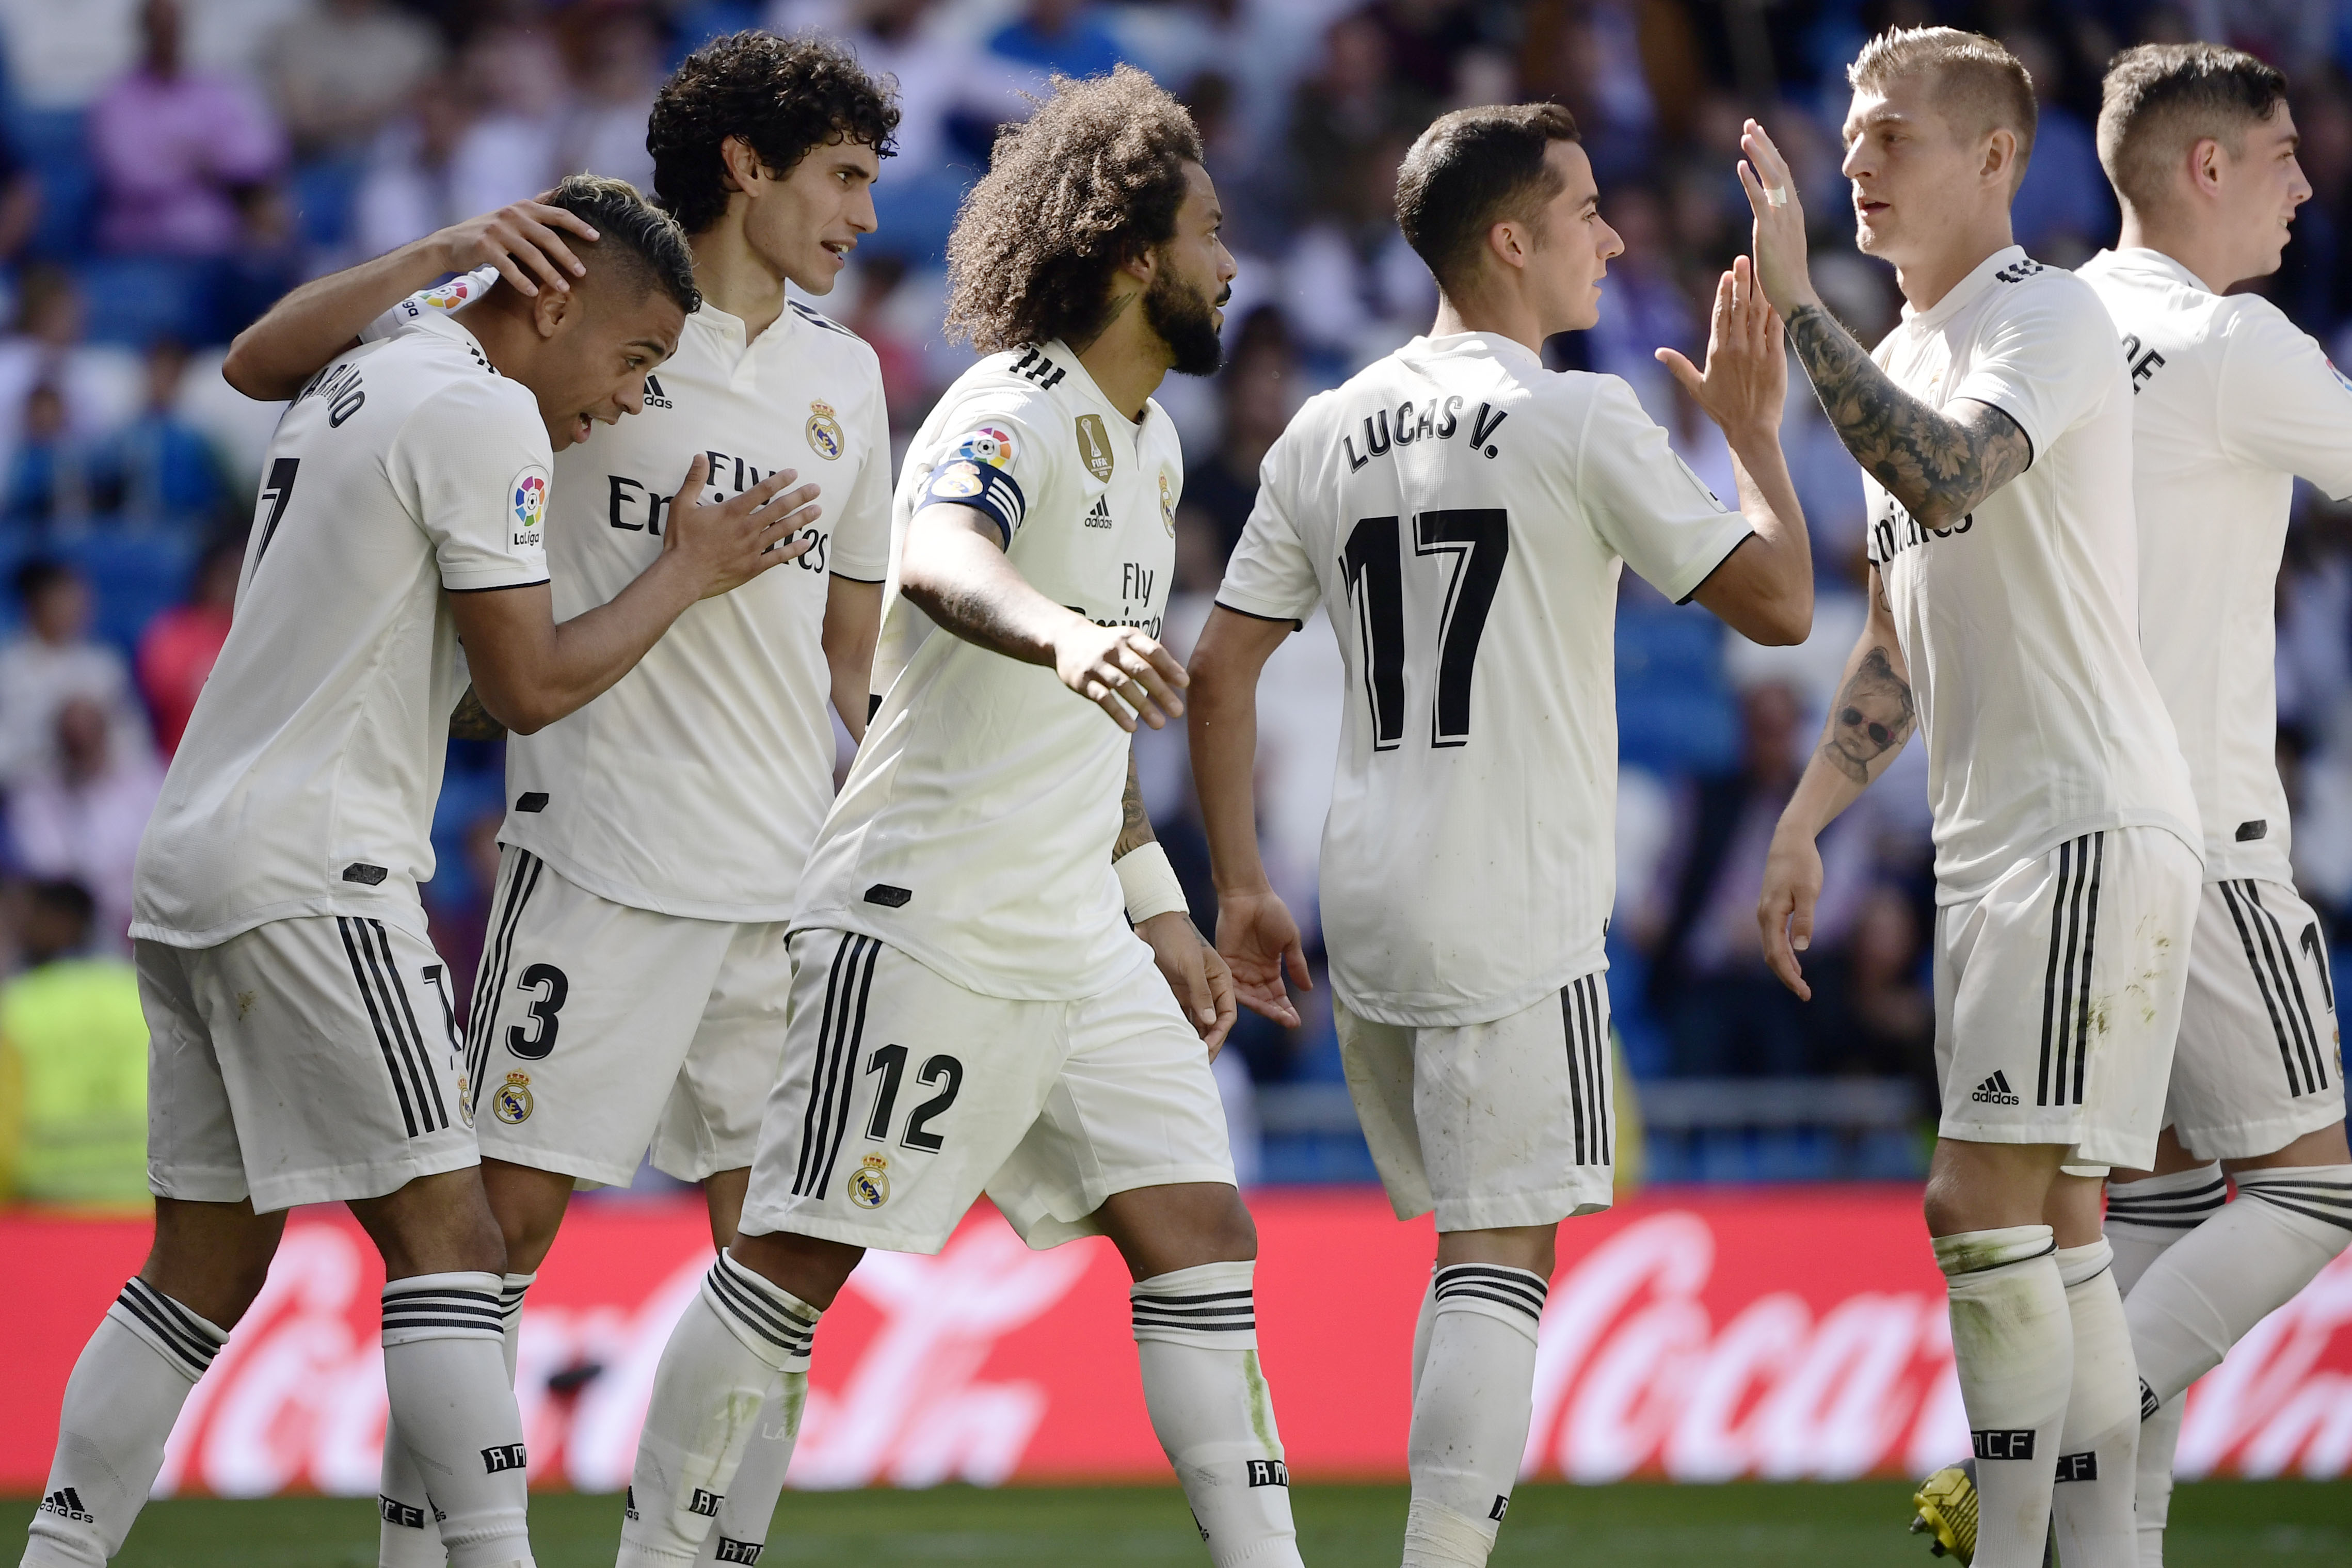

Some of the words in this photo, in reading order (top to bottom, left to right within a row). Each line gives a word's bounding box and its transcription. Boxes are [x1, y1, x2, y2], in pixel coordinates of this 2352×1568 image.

[644, 395, 673, 409] das
[1343, 395, 1464, 474] LUCAS
[1469, 402, 1508, 459] V.
[1091, 457, 1108, 468] FIFA
[1084, 515, 1113, 530] adidas
[514, 530, 540, 547] LaLiga
[1123, 562, 1154, 608] Fly
[1338, 509, 1509, 751] 17
[505, 963, 568, 1060] 3
[865, 1044, 963, 1155] 12
[1972, 1090, 2019, 1106] adidas
[1972, 1432, 2028, 1458] MCF
[40, 1500, 93, 1523] adidas
